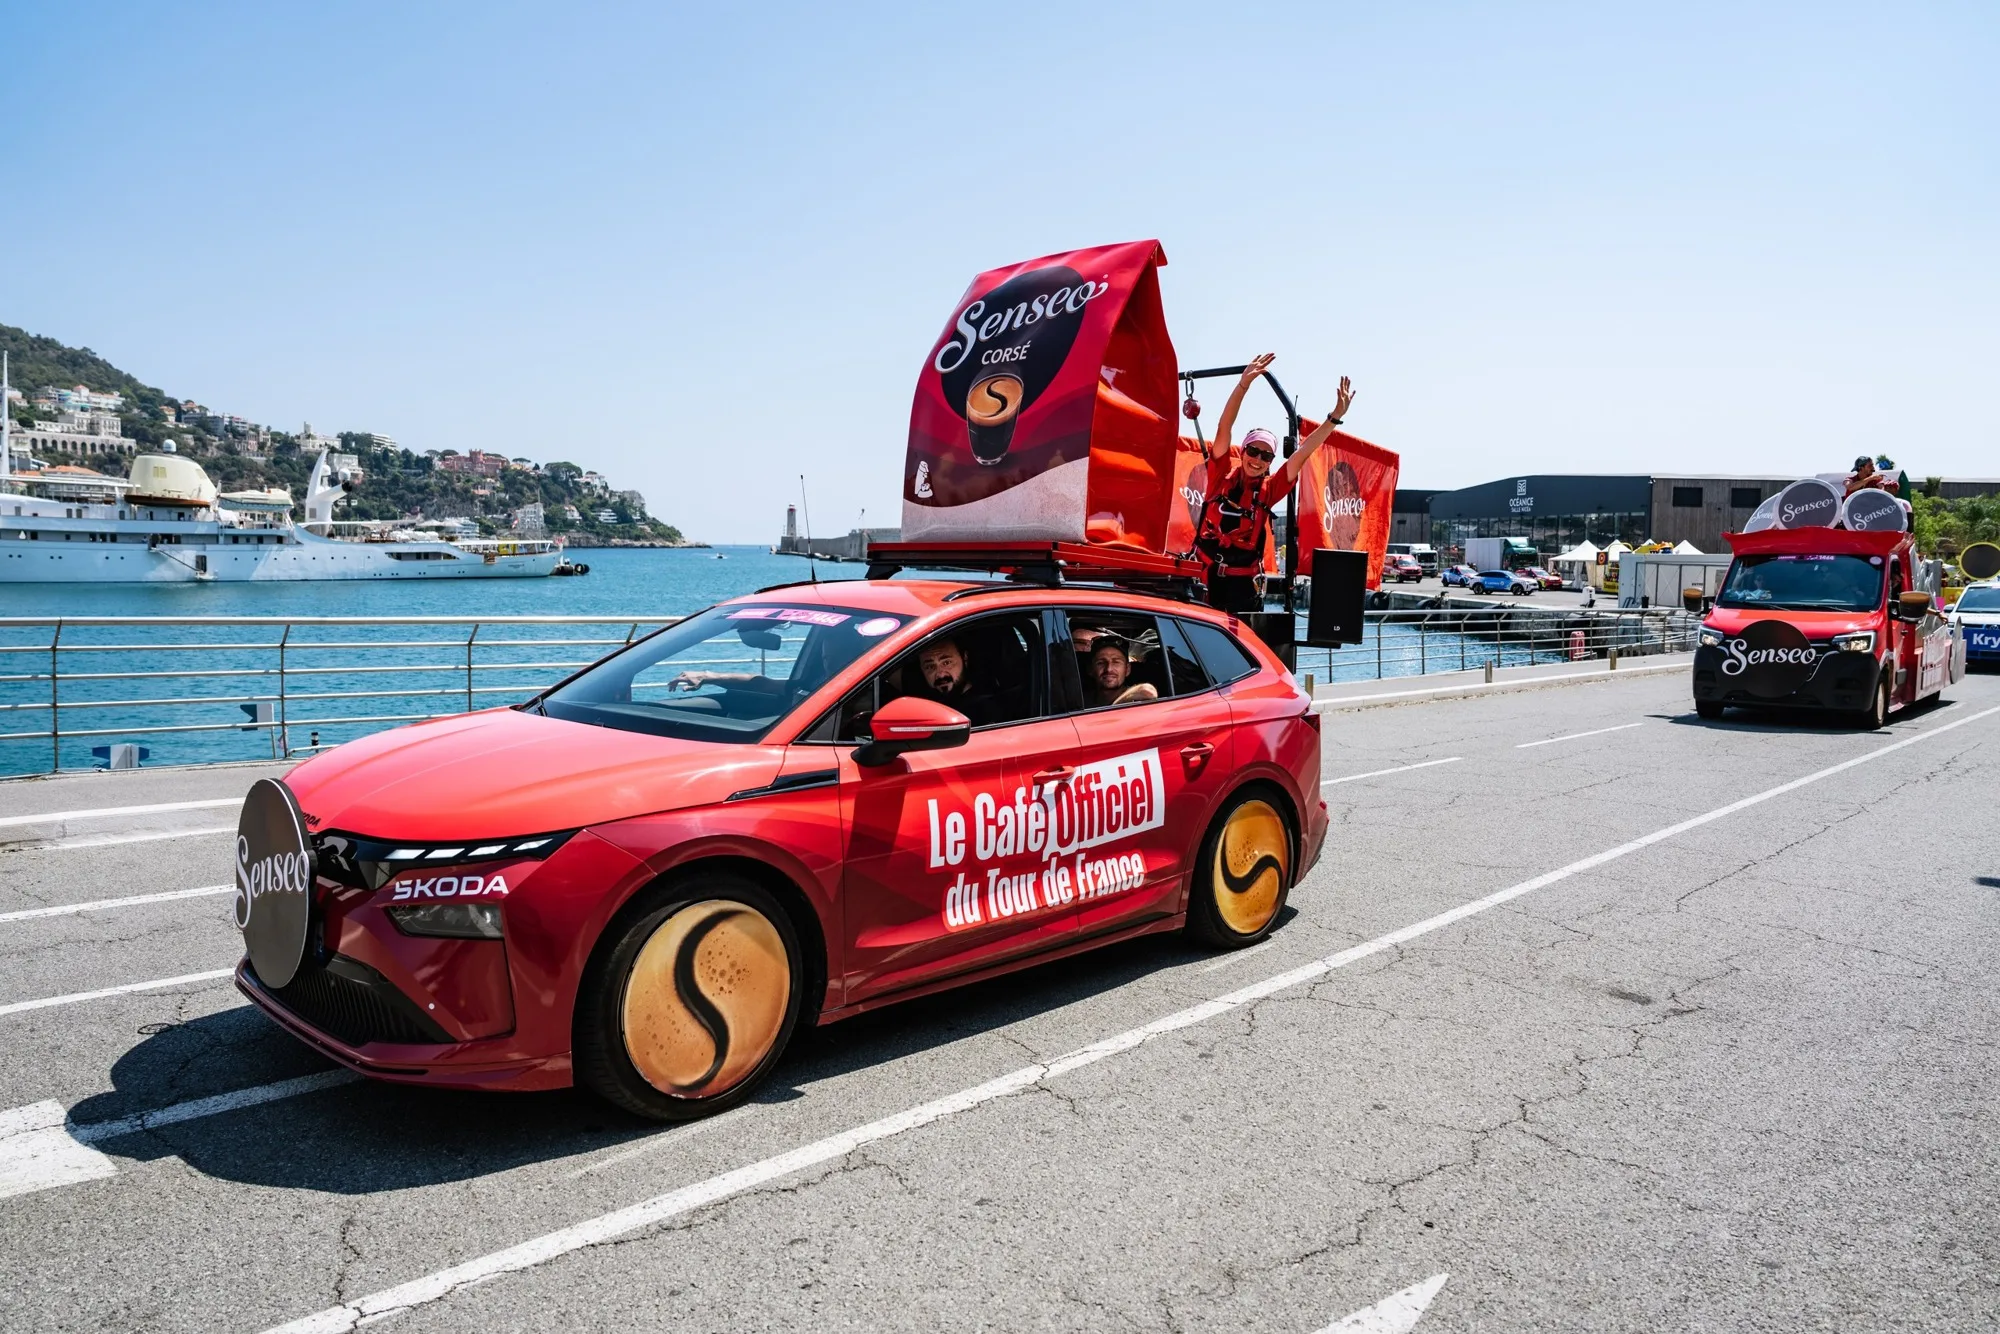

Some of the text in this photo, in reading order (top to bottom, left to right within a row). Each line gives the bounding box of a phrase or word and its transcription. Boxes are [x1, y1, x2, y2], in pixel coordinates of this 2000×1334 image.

[935, 274, 1109, 373] Senseo
[981, 341, 1030, 365] CORSÉ
[1323, 486, 1366, 533] Senseo
[1509, 497, 1534, 507] OCÉANICE
[1782, 498, 1833, 522] Senseo
[1853, 505, 1897, 530] Senseo
[1721, 638, 1817, 676] Senseo
[928, 759, 1153, 868] Le Café Officiel
[234, 835, 310, 929] Senseo
[392, 875, 509, 900] SKODA
[946, 853, 1145, 927] du Tour de France
